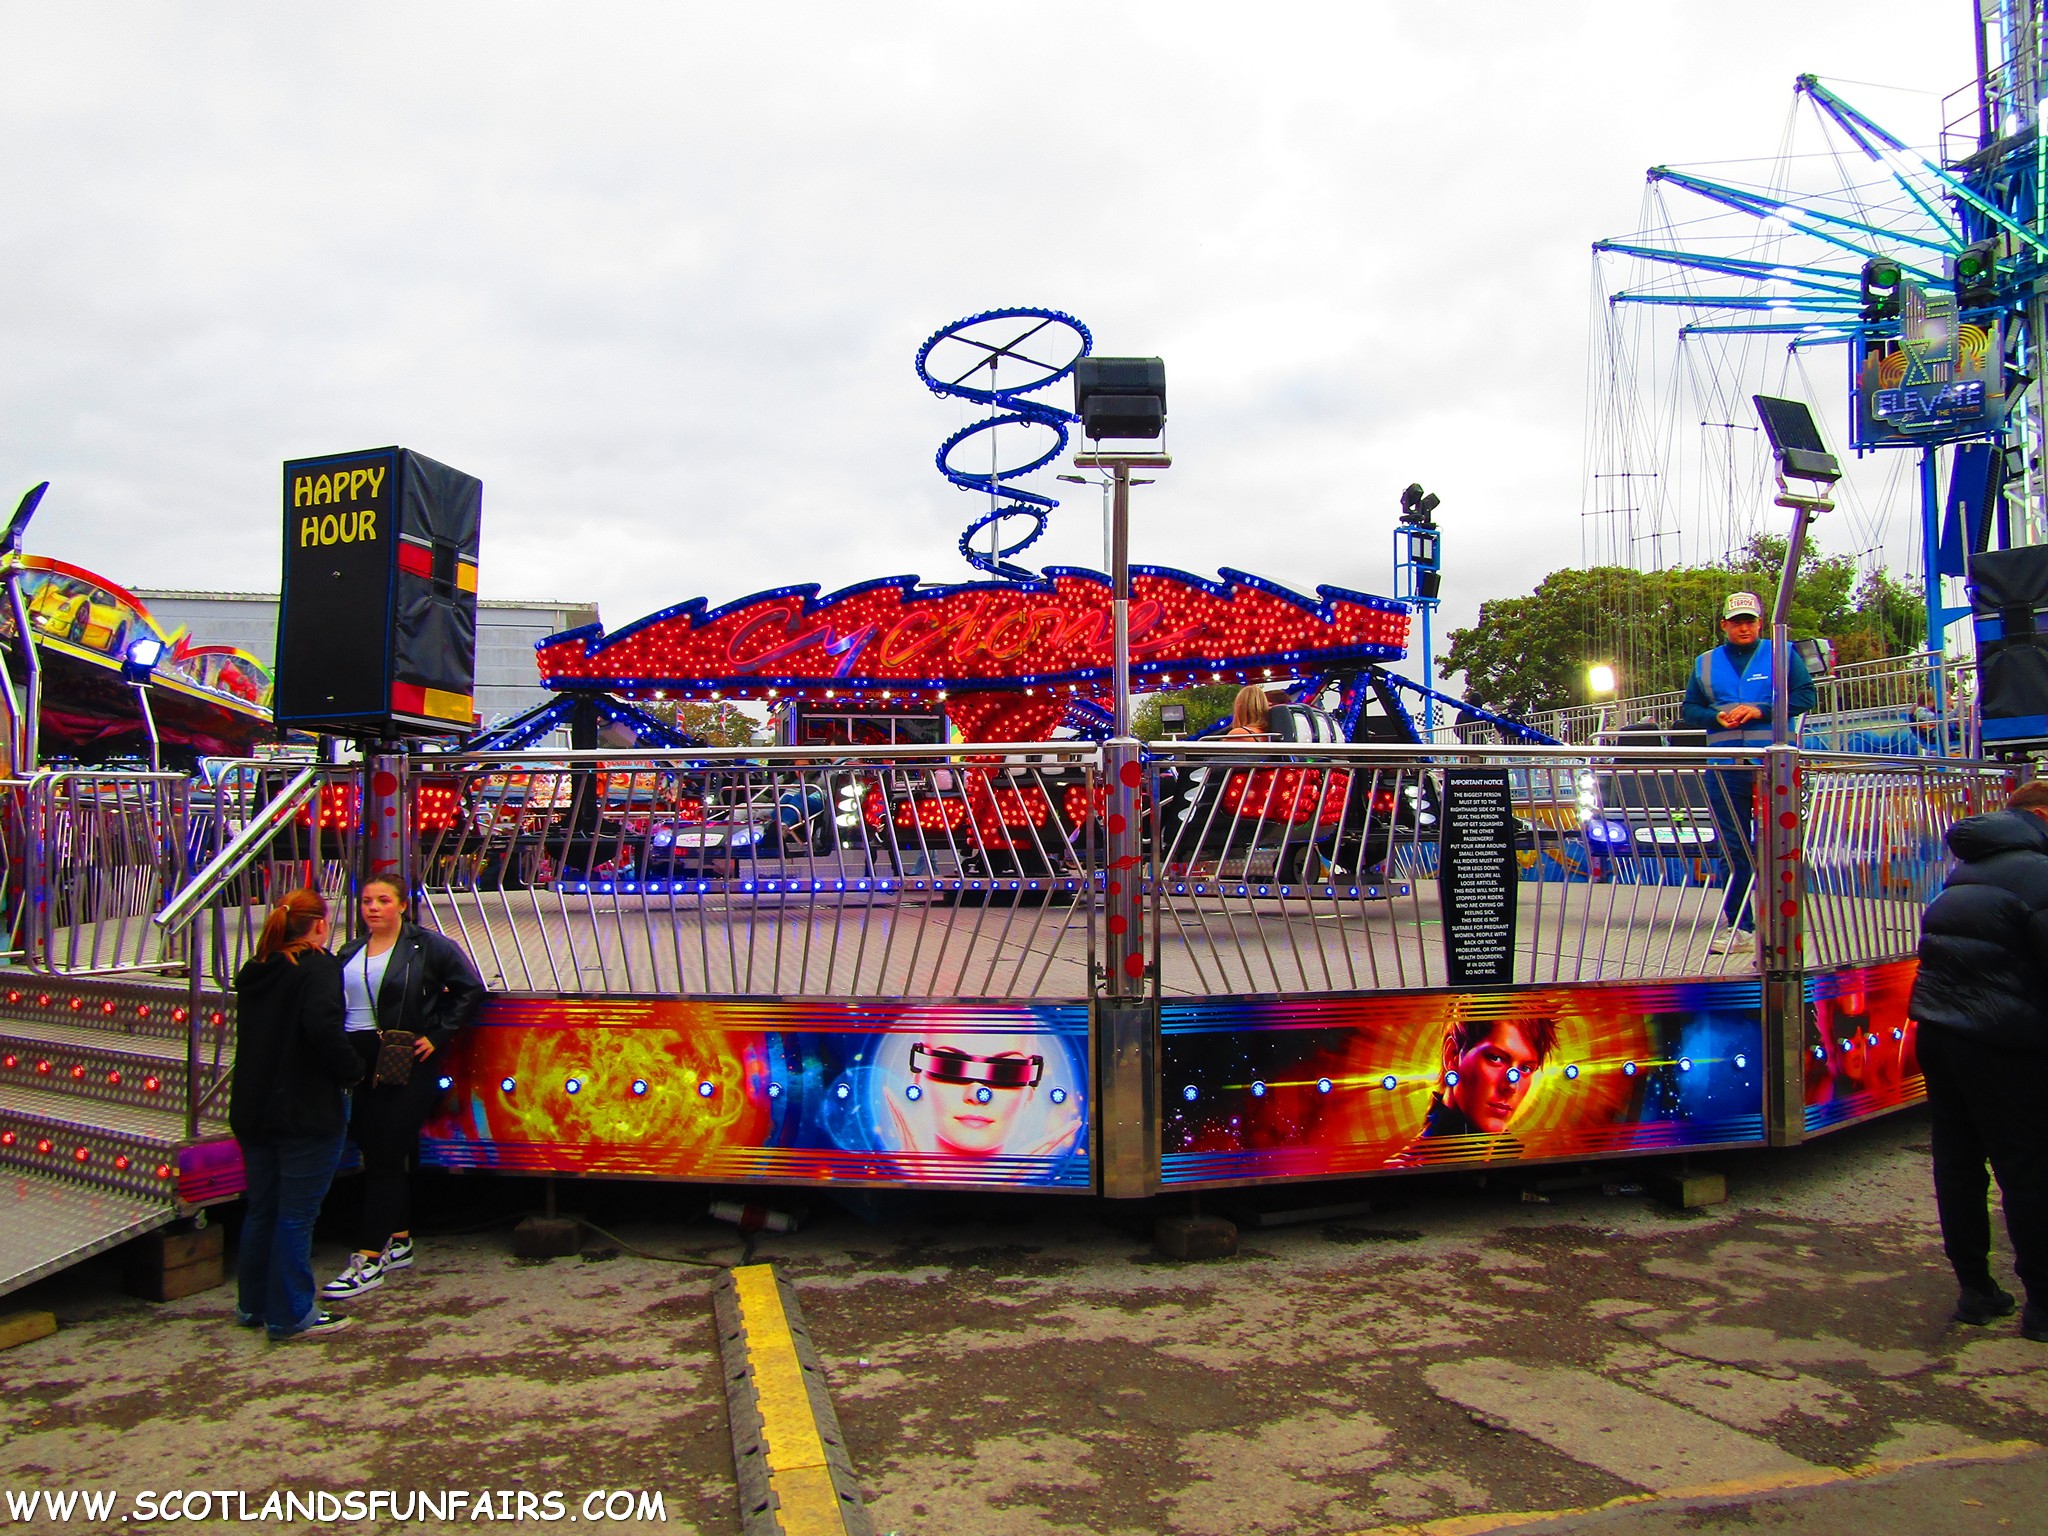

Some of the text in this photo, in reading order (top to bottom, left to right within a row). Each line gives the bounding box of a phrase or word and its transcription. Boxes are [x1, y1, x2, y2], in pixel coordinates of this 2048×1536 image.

[294, 466, 385, 507] HAPPY
[301, 510, 377, 547] HOUR
[726, 593, 1204, 678] Cyclone
